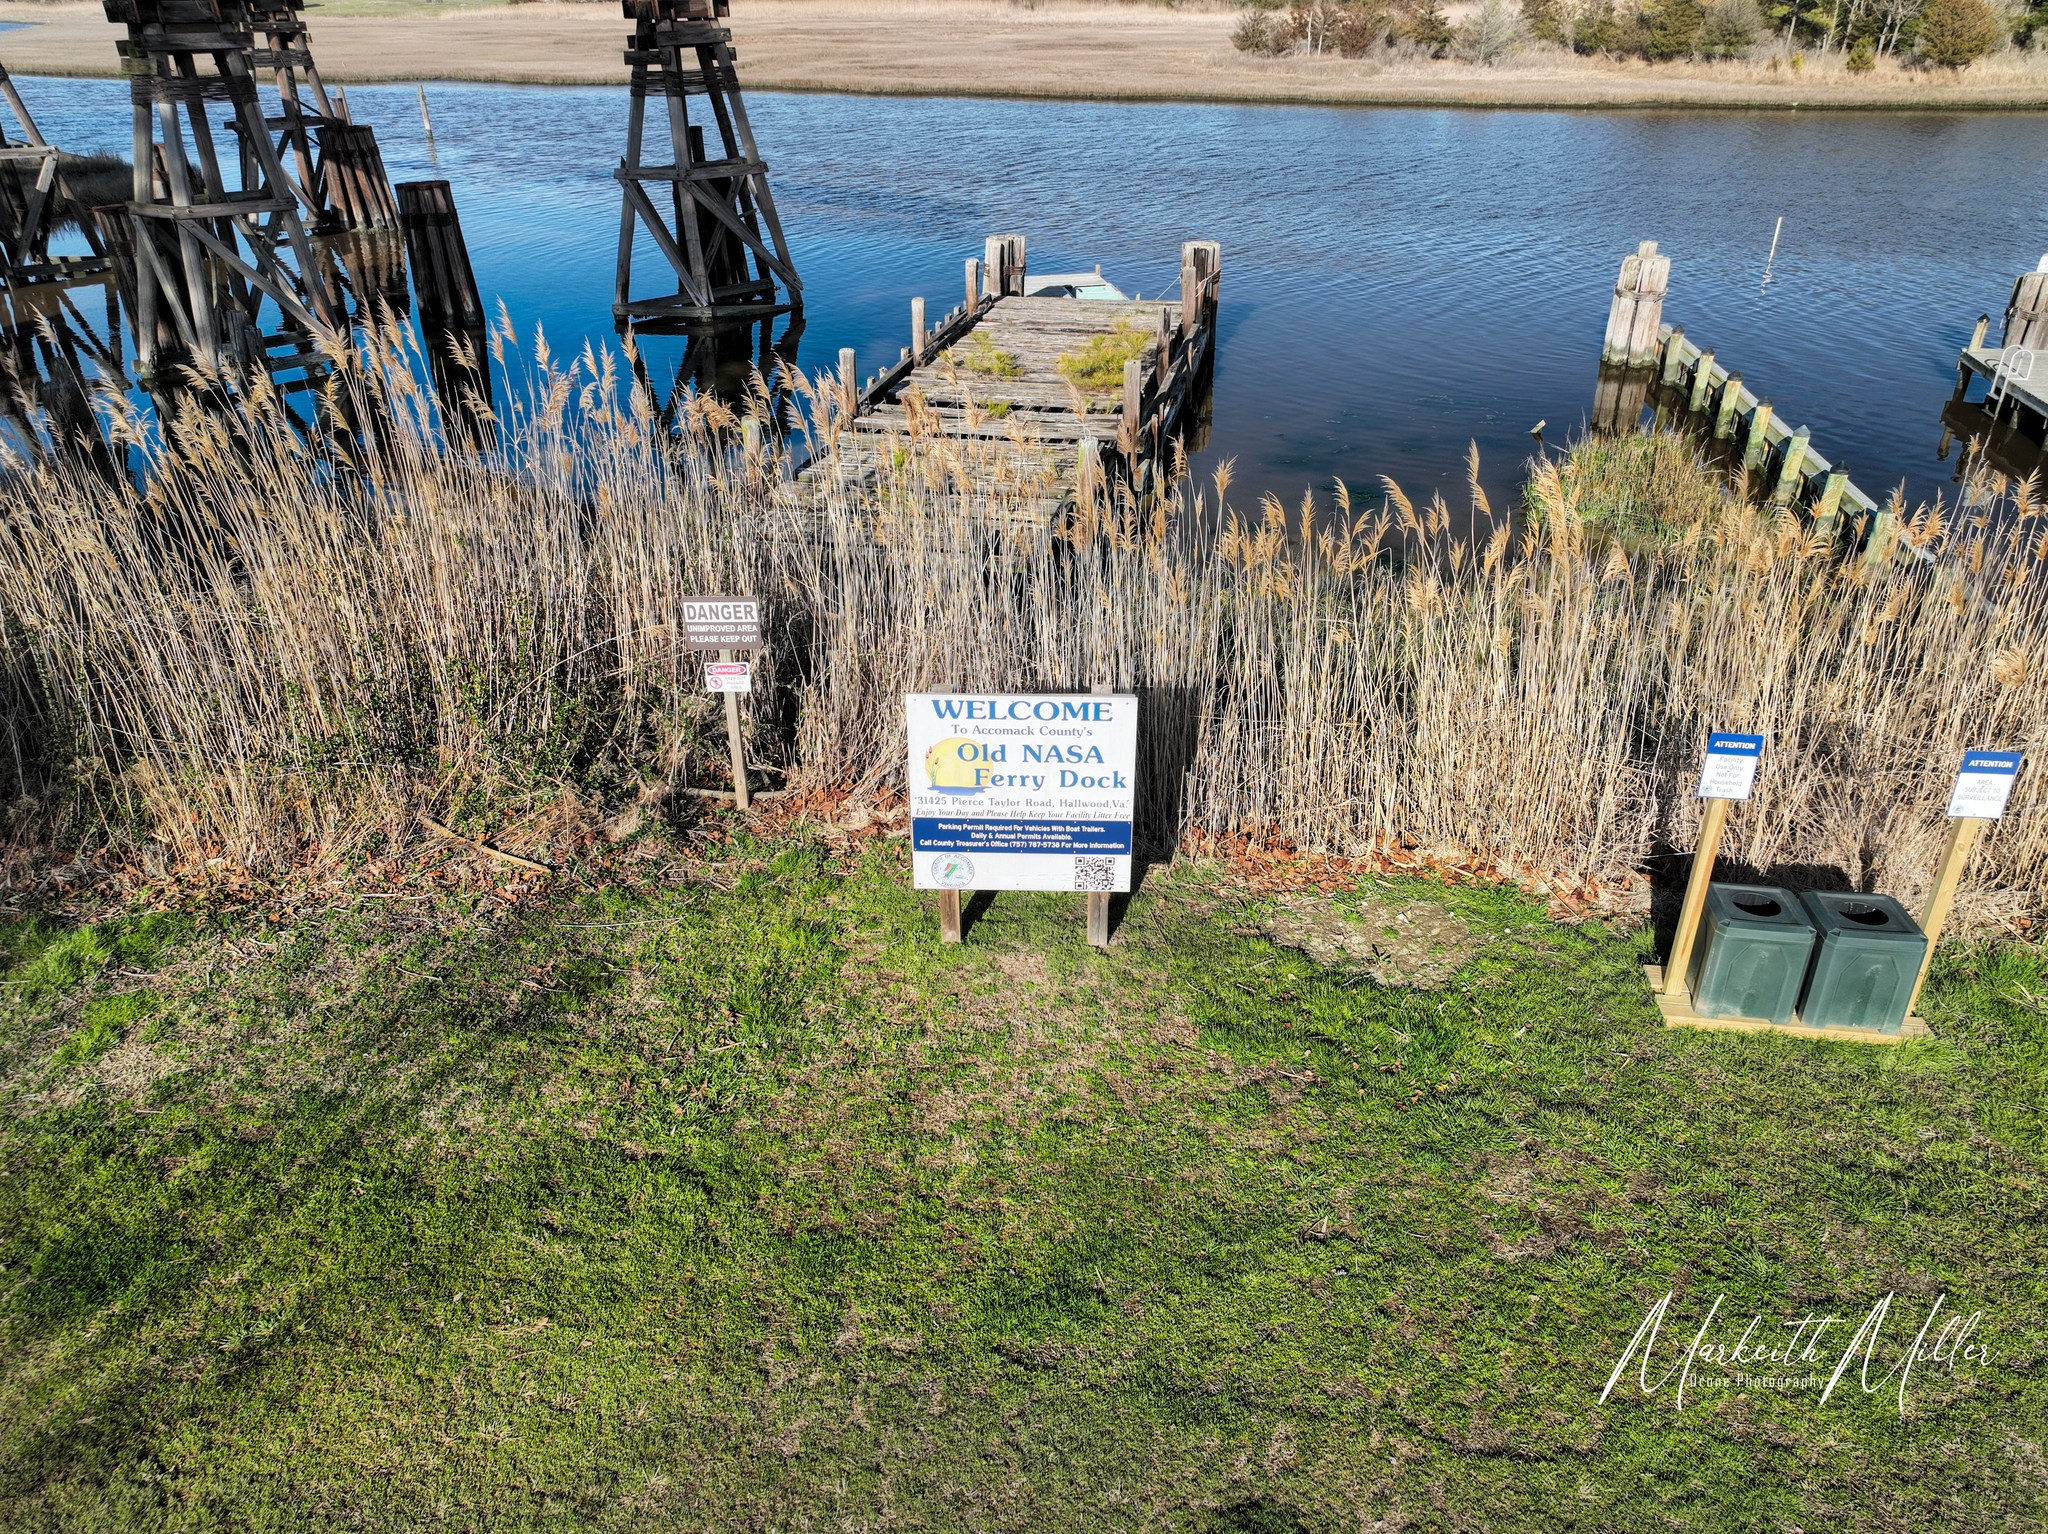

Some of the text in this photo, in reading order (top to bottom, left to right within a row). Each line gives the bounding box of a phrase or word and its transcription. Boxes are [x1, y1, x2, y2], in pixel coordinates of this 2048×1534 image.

[686, 604, 755, 620] DANGER
[931, 700, 1113, 722] WELCOME
[951, 724, 1093, 738] To Accomack County's
[1714, 741, 1756, 749] ATTENTION
[957, 743, 1104, 764] Old NASA
[1719, 756, 1744, 764] Facility
[1968, 760, 2013, 768] ATTENTION
[1729, 764, 1744, 772] Only
[974, 768, 1127, 791] Ferry Dock
[952, 797, 984, 806] Pierce
[988, 798, 1020, 808] Taylor
[1025, 799, 1055, 808] Road,
[1958, 794, 2003, 802] SURVEILLANCE
[916, 808, 936, 817] Enjoy
[939, 808, 954, 816] Your
[956, 809, 969, 817] Day
[1010, 810, 1027, 818] Help
[1028, 811, 1045, 819] Keep
[1066, 811, 1091, 820] Facility
[1093, 811, 1112, 819] Litter
[938, 823, 962, 831] Parking
[985, 824, 1012, 832] Required
[971, 832, 987, 840] Daily
